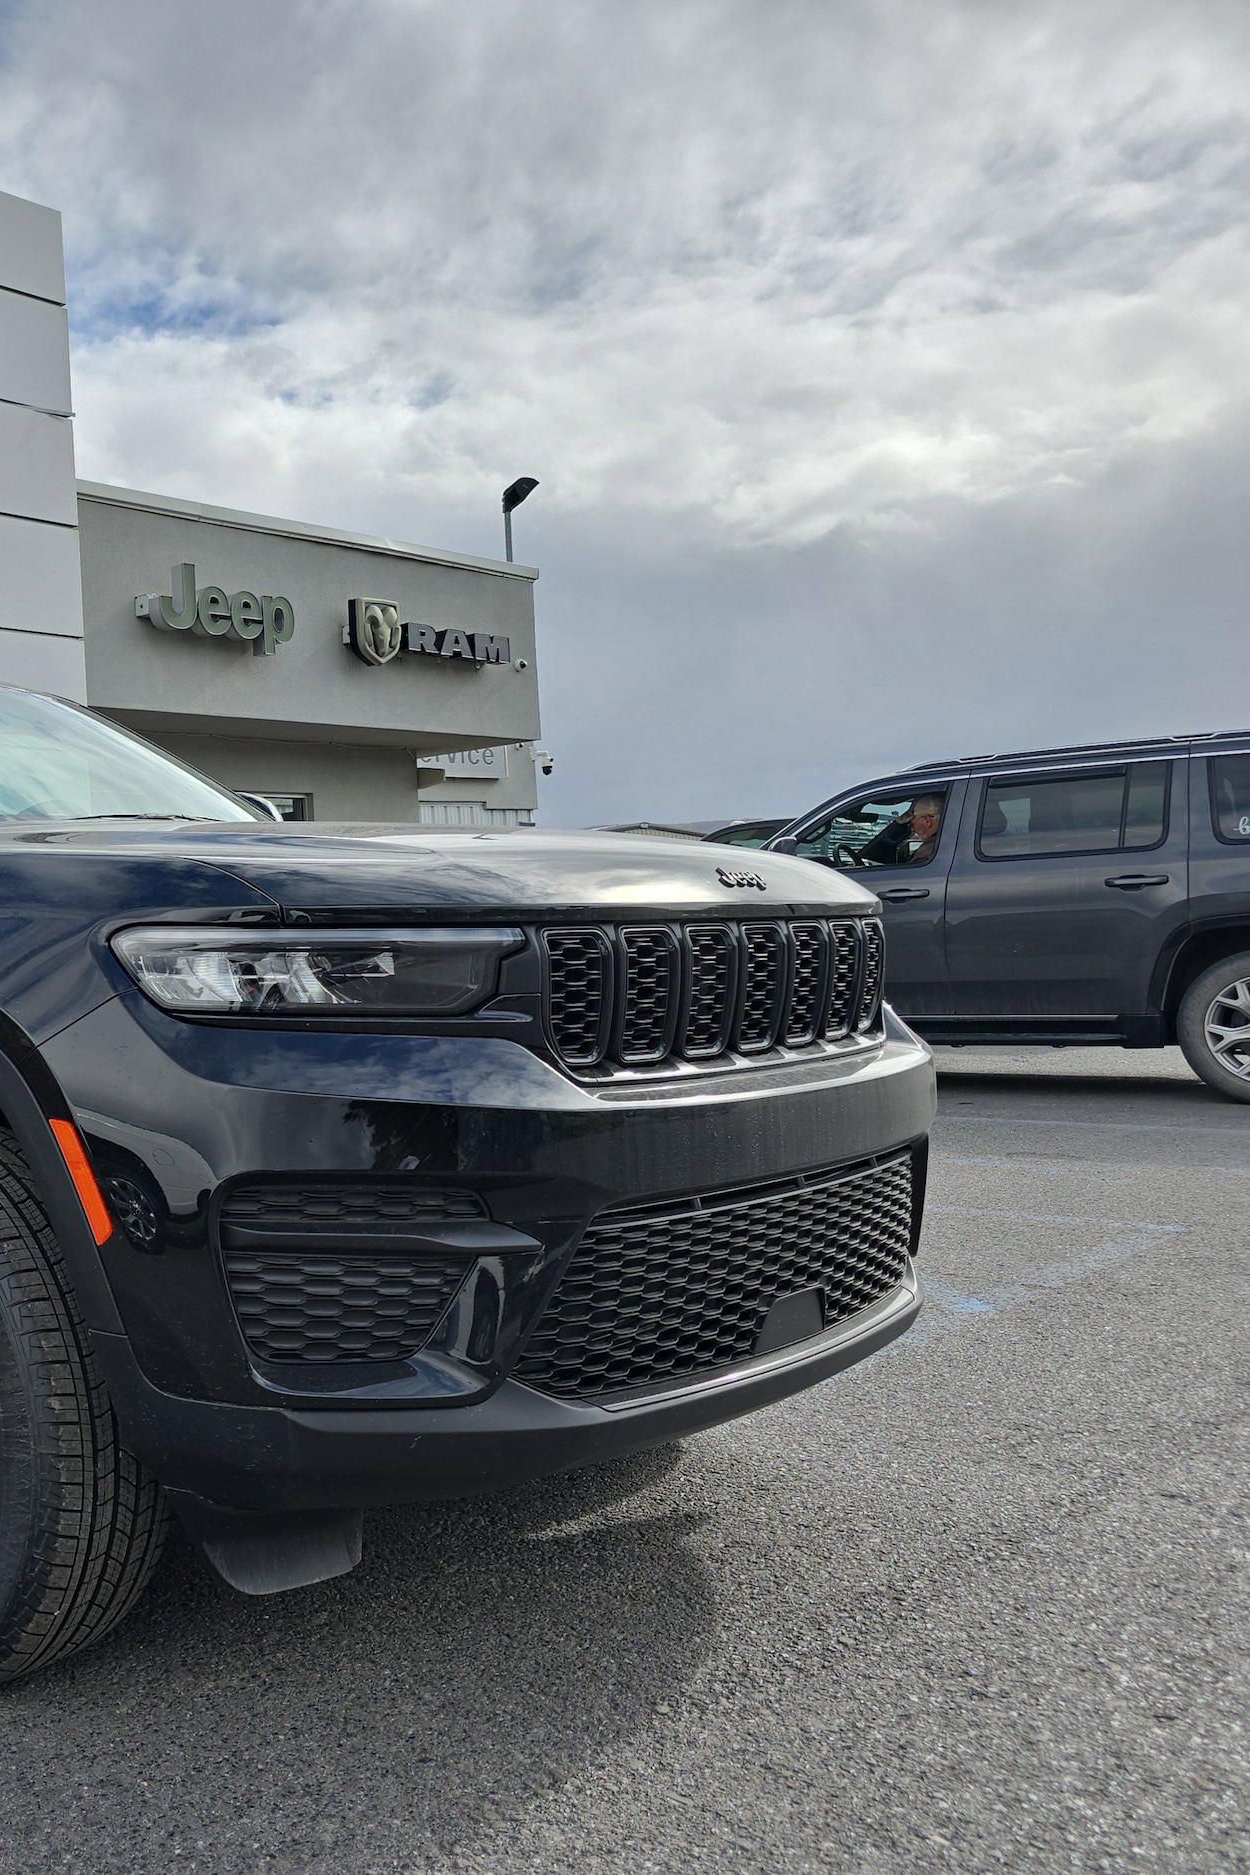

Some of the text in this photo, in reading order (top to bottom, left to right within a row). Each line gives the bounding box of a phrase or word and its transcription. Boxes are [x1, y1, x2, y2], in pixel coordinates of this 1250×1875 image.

[149, 562, 295, 657] Jeep
[400, 622, 510, 665] RAM
[715, 867, 767, 891] Jeep
